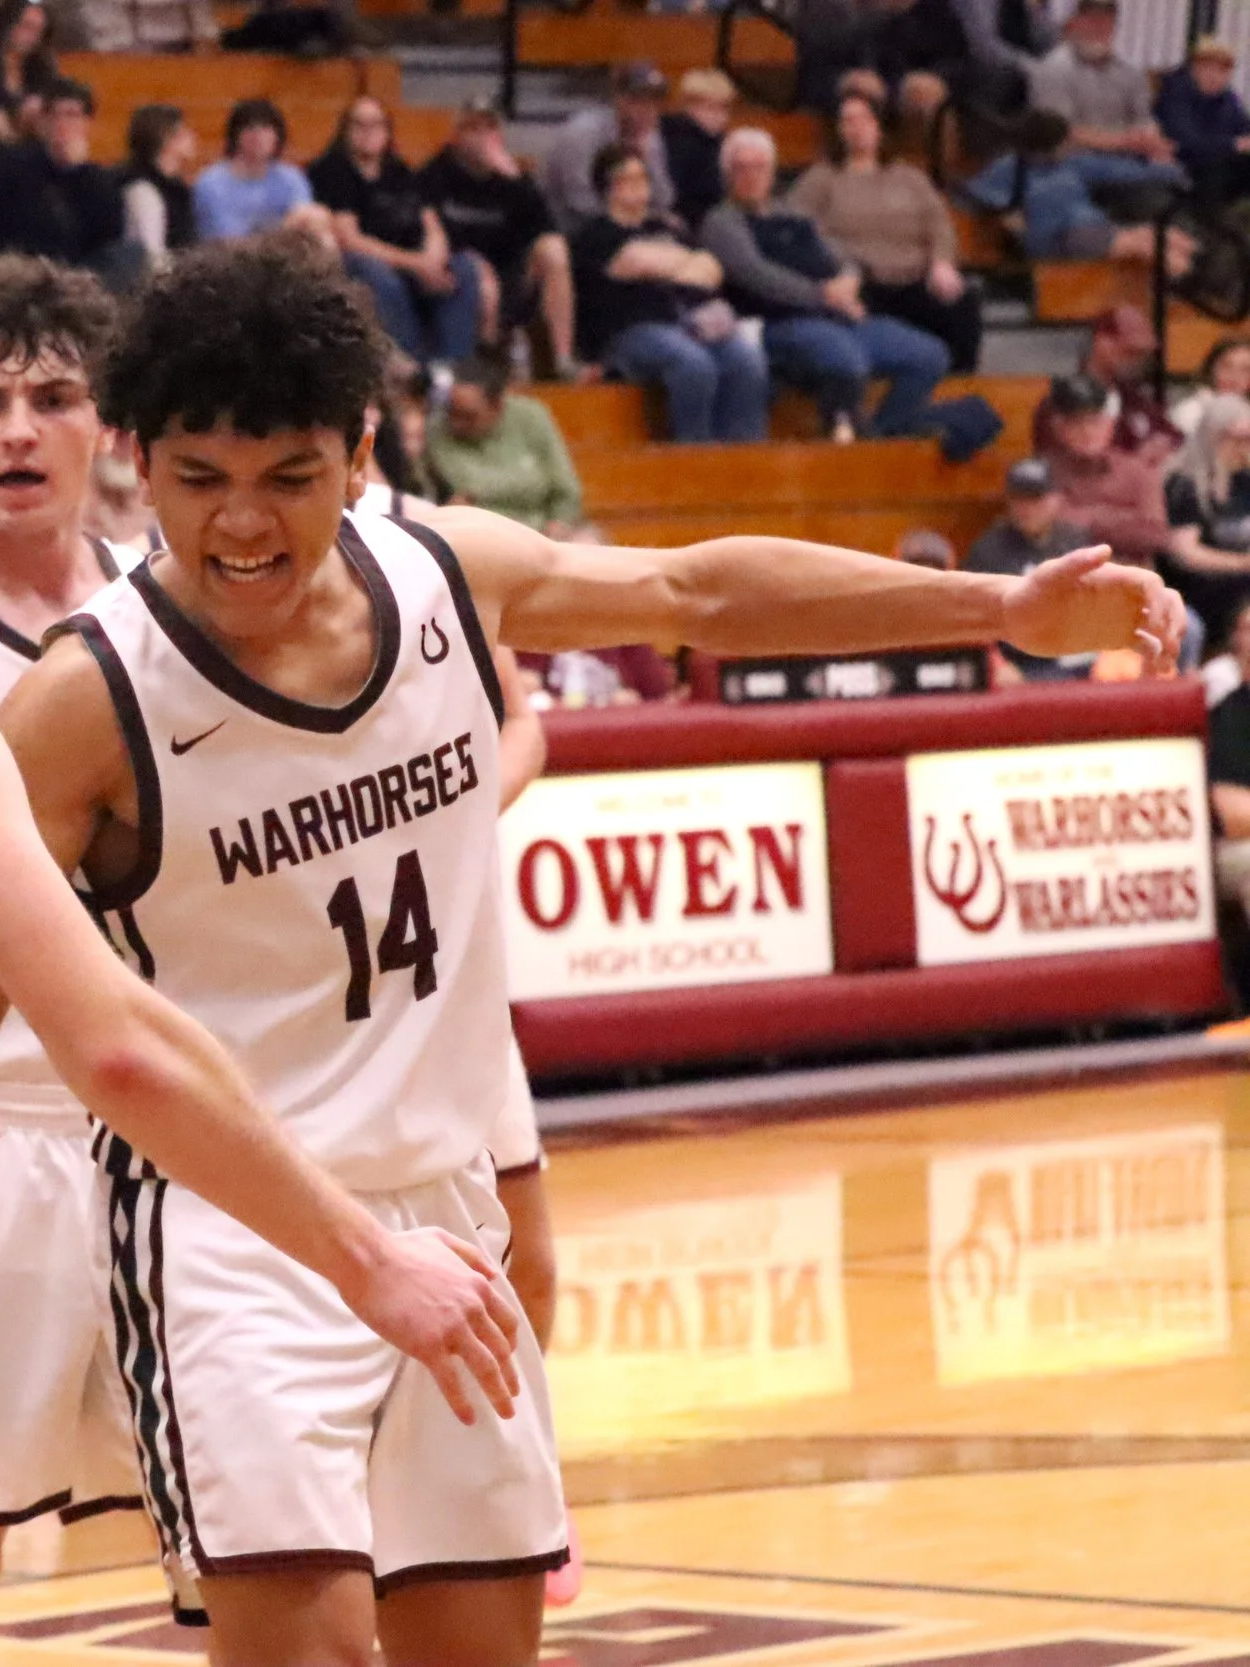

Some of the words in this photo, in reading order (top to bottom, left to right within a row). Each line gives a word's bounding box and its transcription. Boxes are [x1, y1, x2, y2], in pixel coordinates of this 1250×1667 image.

[209, 732, 479, 885] WARHORSES
[1005, 788, 1193, 851] WARHORSES
[518, 823, 804, 933] OWEN
[327, 849, 439, 1022] 14
[567, 946, 640, 979] HIGH
[652, 938, 769, 975] SCHOOL
